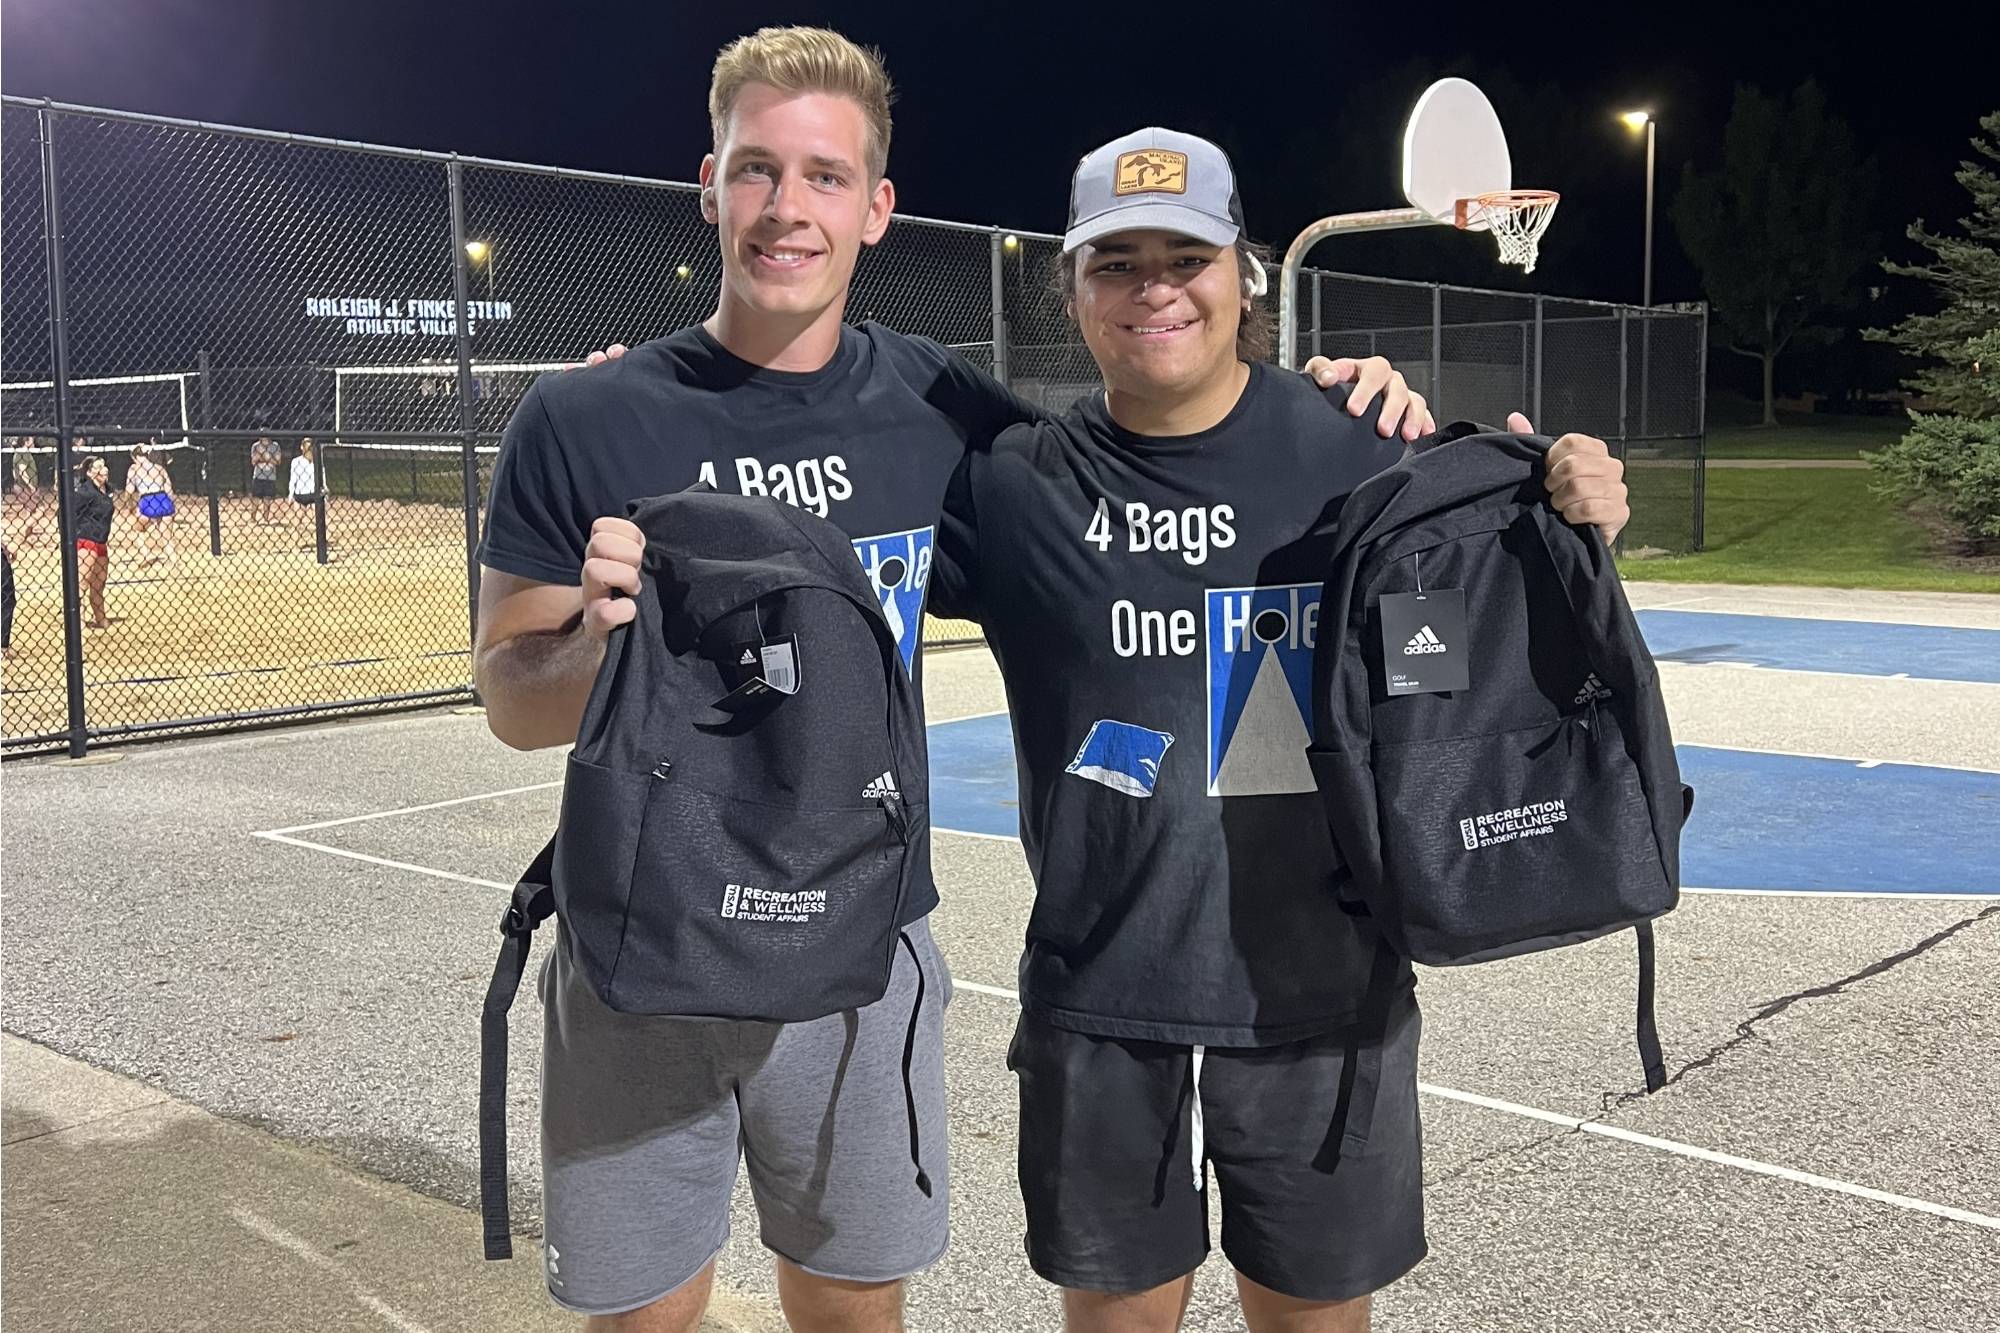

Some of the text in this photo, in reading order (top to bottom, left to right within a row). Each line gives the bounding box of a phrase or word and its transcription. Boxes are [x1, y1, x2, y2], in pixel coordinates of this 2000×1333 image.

[307, 298, 512, 319] RALEIGH J. FINKESTEIN
[346, 319, 476, 336] ATHLETIC VILLAE
[735, 455, 853, 519] Bags
[1084, 497, 1236, 566] 4 Bags
[1111, 588, 1321, 658] One Hole
[1404, 643, 1447, 655] adidas
[1476, 799, 1565, 827] RECREATION
[1479, 811, 1568, 838] & WELLNESS
[1462, 819, 1475, 847] GVSU
[1480, 825, 1554, 847] STUDENT AFFAIRS
[724, 886, 738, 915] GVSU
[740, 899, 826, 914] & WELLNESS
[742, 887, 827, 903] RECREATION
[737, 912, 809, 922] STUDENT AFFAIRS
